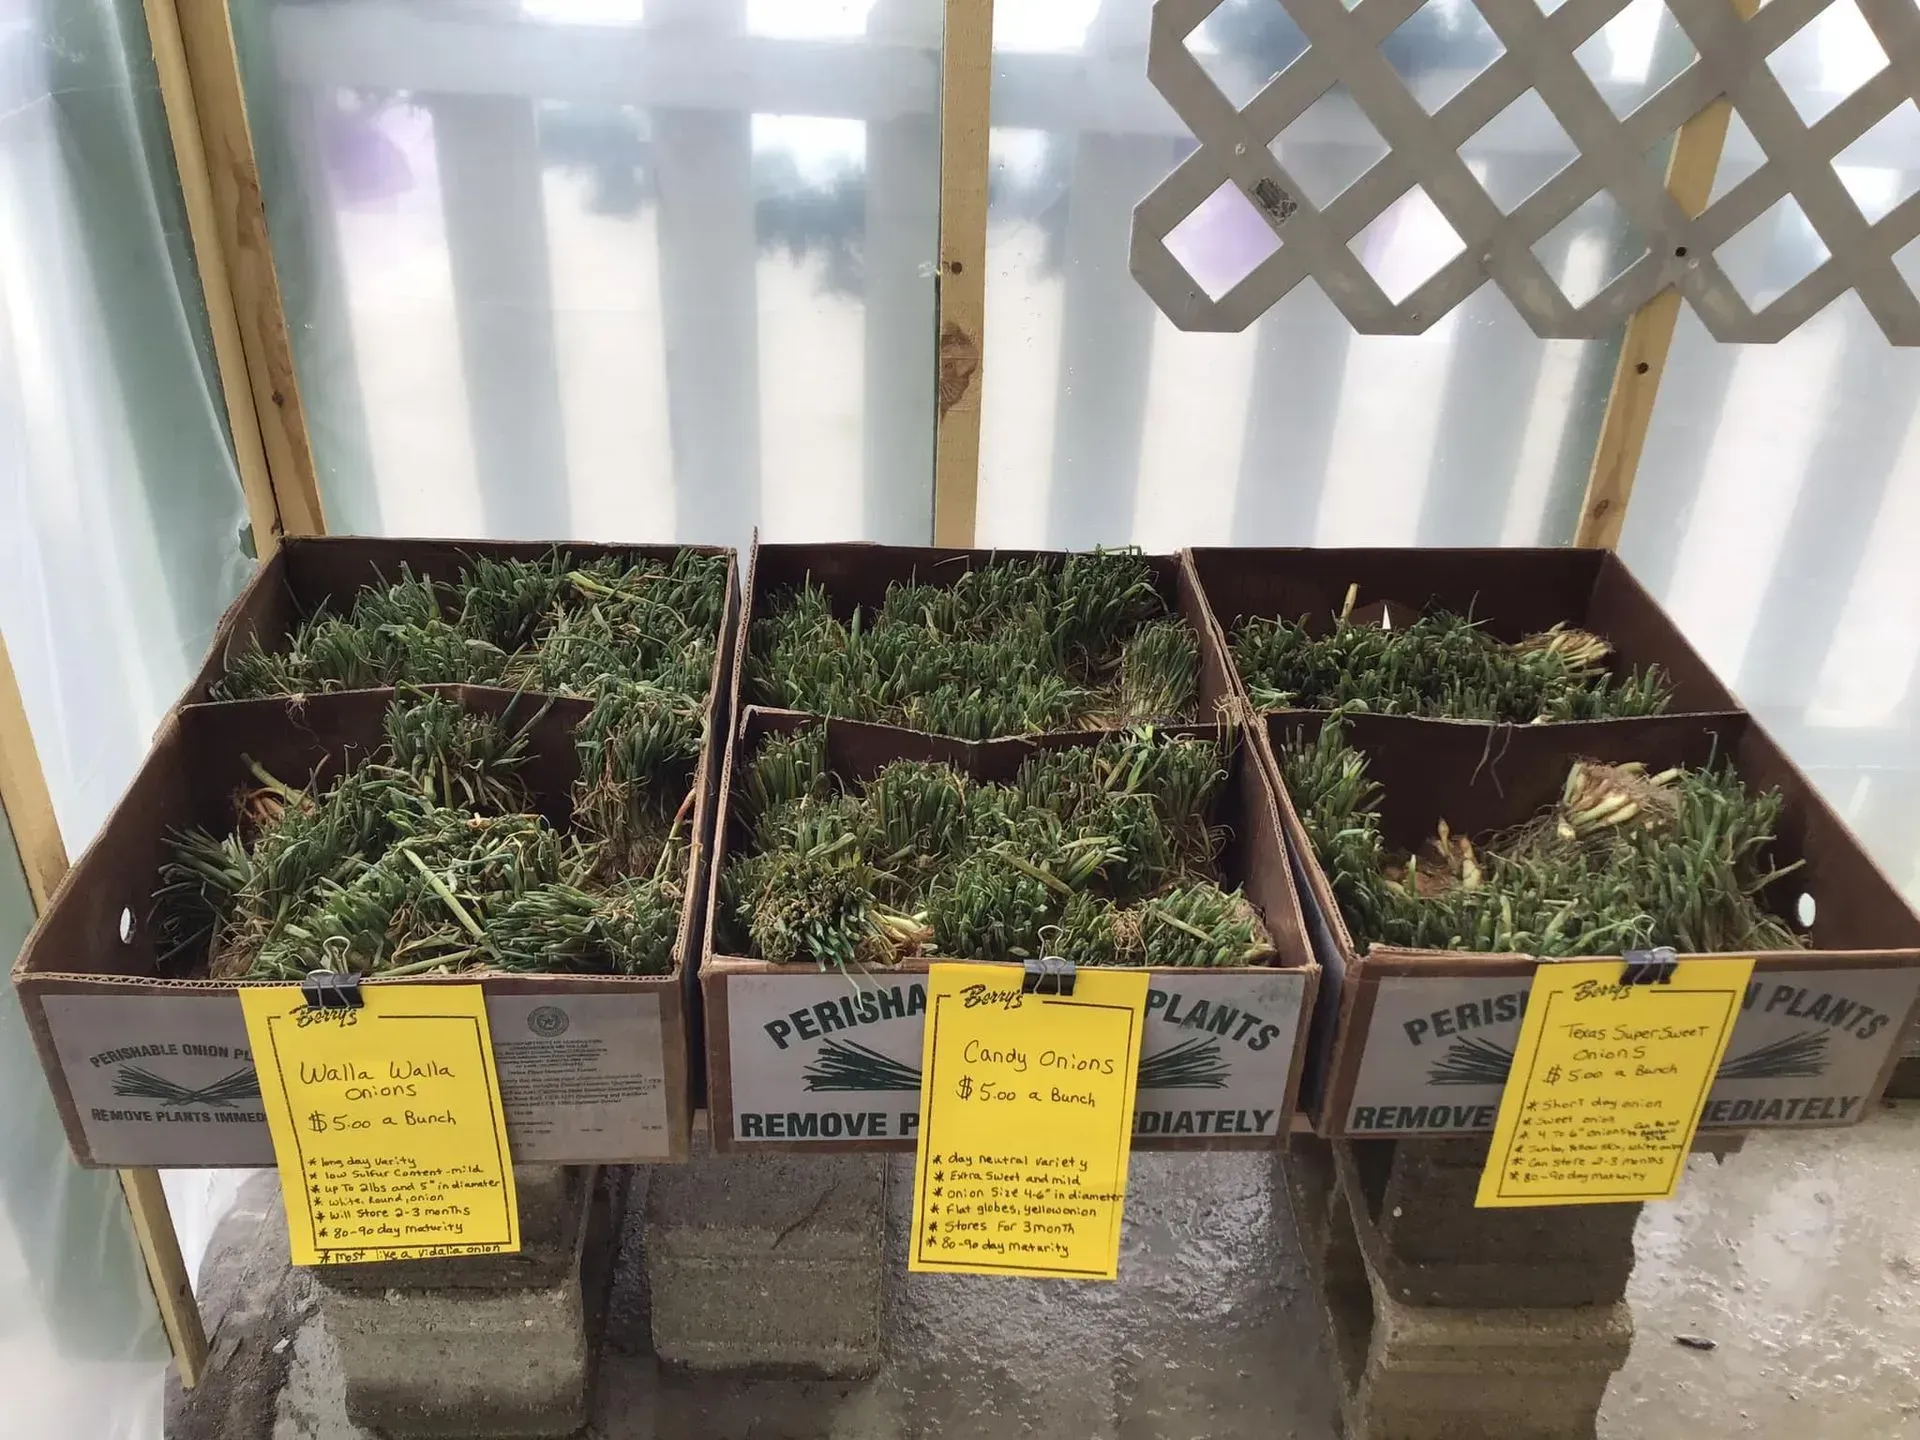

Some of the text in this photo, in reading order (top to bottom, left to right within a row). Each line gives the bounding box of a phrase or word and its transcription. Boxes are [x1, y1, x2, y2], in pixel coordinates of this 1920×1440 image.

[764, 983, 1280, 1051] PERISHA PLANTS
[1765, 984, 1890, 1040] PLANTS
[1560, 1023, 1606, 1039] Texas
[90, 1044, 254, 1067] PERISHABLE ONION PL
[964, 1040, 1114, 1074] Candy Onions
[300, 1061, 455, 1084] Walla Walla
[1635, 1064, 1678, 1076] Bunch
[1029, 1090, 1042, 1100] a
[1051, 1087, 1095, 1108] Bunch
[1591, 1096, 1617, 1110] day
[1621, 1100, 1662, 1108] onion
[91, 1108, 266, 1122] REMOVE PLANTS IMMED
[382, 1116, 398, 1125] a
[404, 1110, 456, 1125] Bunch
[1352, 1105, 1496, 1128] REMOVE
[740, 1112, 887, 1137] REMOVE
[347, 1156, 371, 1168] day
[948, 1152, 972, 1166] day
[950, 1170, 982, 1180] Extra
[1026, 1174, 1048, 1183] and
[1052, 1175, 1080, 1185] mild
[1567, 1170, 1588, 1182] day
[392, 1182, 414, 1192] and
[1069, 1190, 1122, 1202] diameter
[977, 1202, 1020, 1216] globes,
[377, 1223, 400, 1238] day
[982, 1238, 1004, 1254] day
[401, 1250, 412, 1258] a
